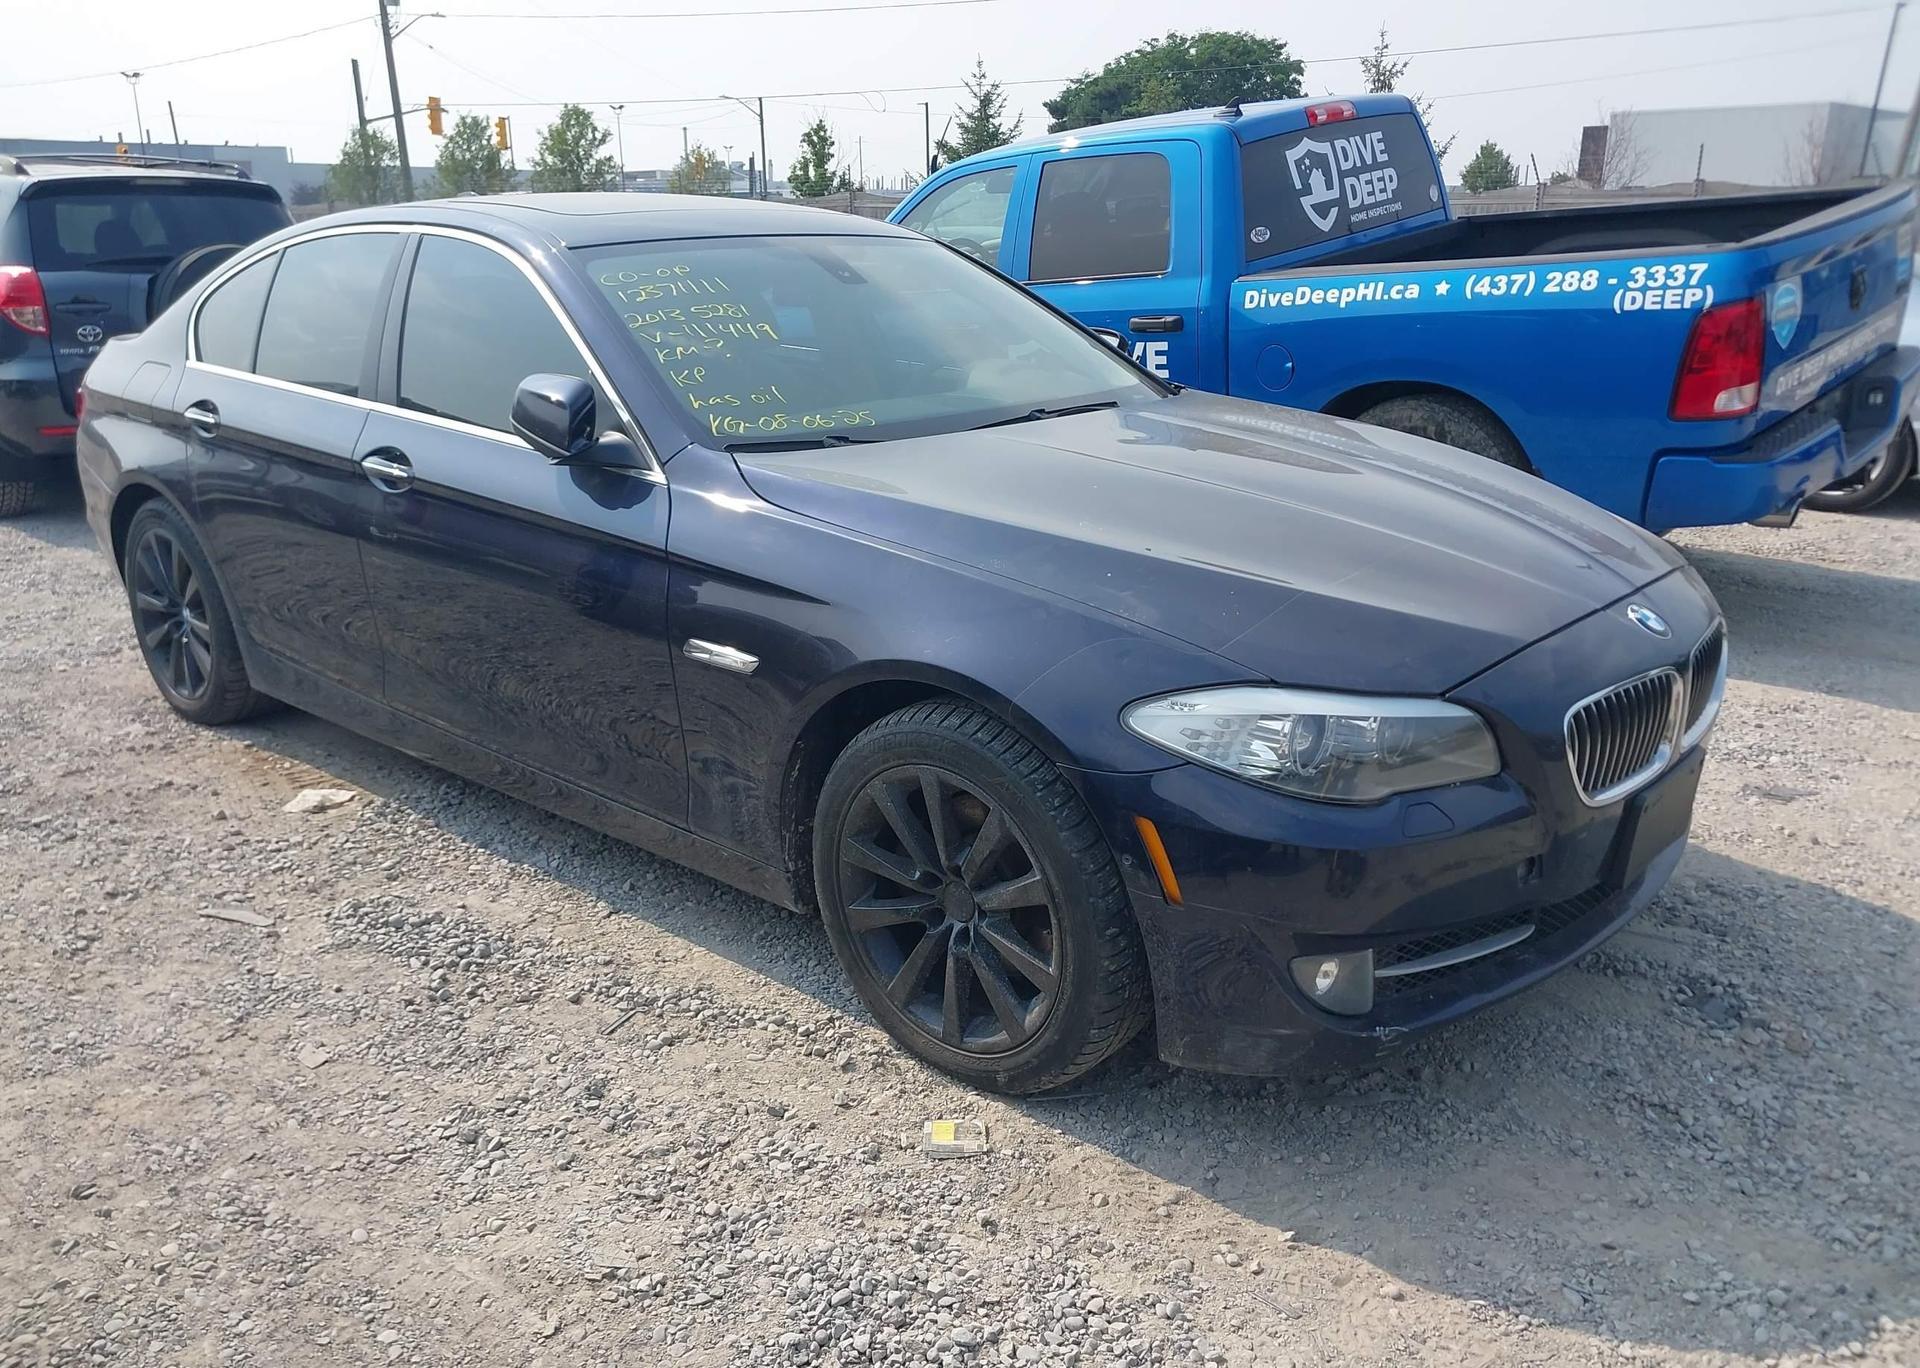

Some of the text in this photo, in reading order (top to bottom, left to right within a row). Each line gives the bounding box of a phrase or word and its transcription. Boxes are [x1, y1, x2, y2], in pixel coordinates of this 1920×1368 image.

[1333, 131, 1389, 171] DIVE
[1344, 167, 1399, 208] DEEP
[1350, 201, 1402, 223] HOME INSPECTIONS
[1244, 281, 1421, 310] DiveDeepHI.ca
[1465, 271, 1536, 299] (437)
[1543, 269, 1599, 293] 288
[1627, 262, 1709, 288] 3337
[1613, 284, 1714, 314] (DEEP)
[624, 308, 686, 329] 2013
[688, 392, 741, 409] has
